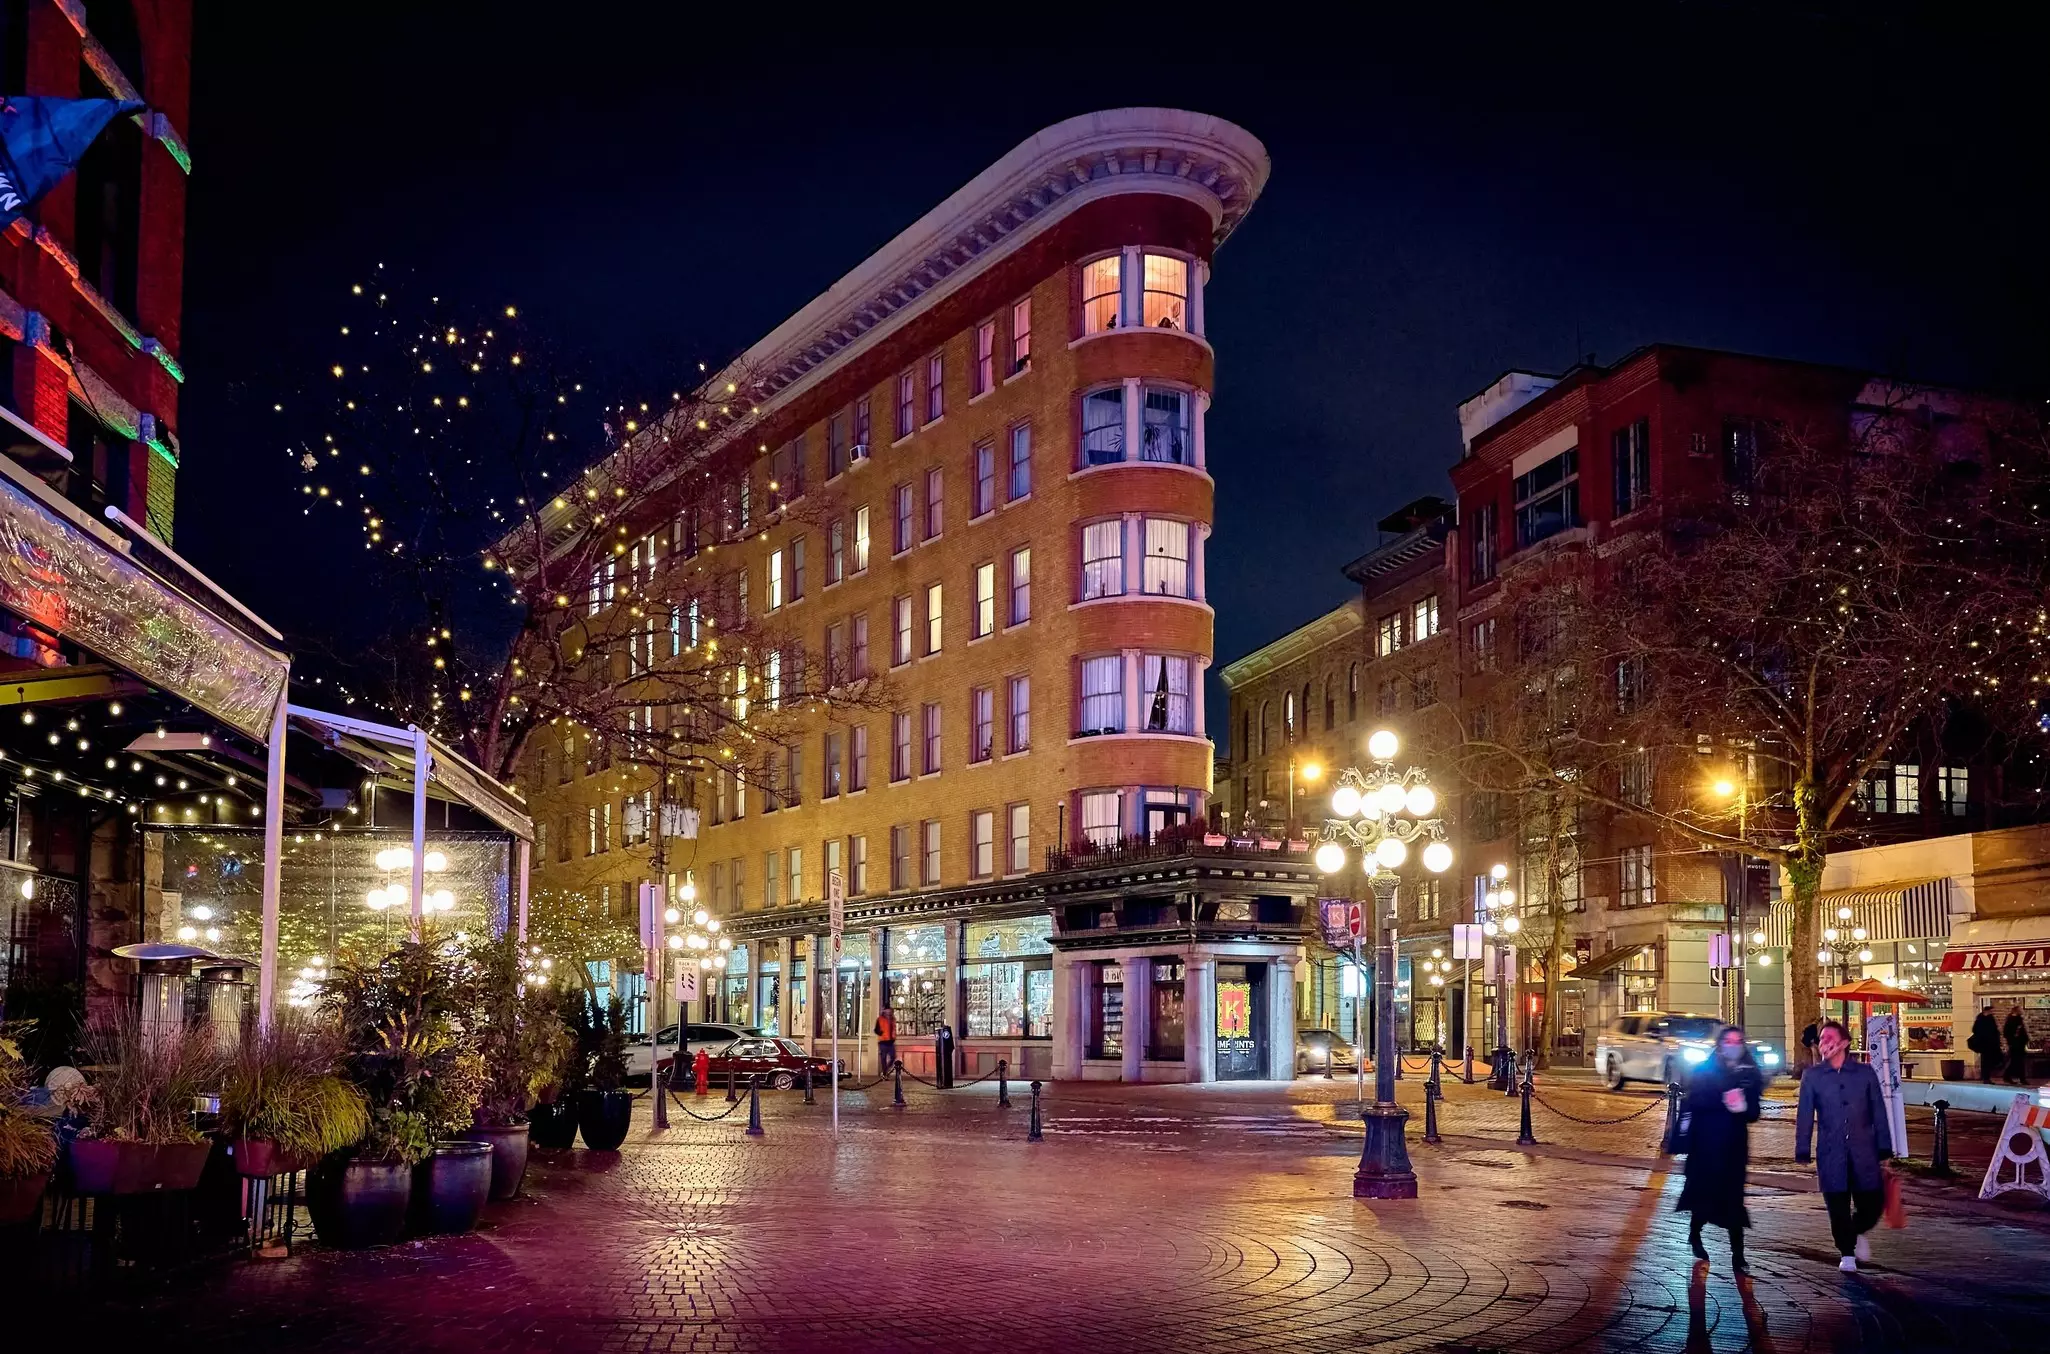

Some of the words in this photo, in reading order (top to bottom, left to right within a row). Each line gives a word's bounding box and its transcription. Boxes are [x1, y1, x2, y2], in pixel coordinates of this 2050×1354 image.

[1961, 949, 2050, 970] INDIA
[1225, 1000, 1241, 1020] K
[1217, 1040, 1255, 1048] IMPINTS
